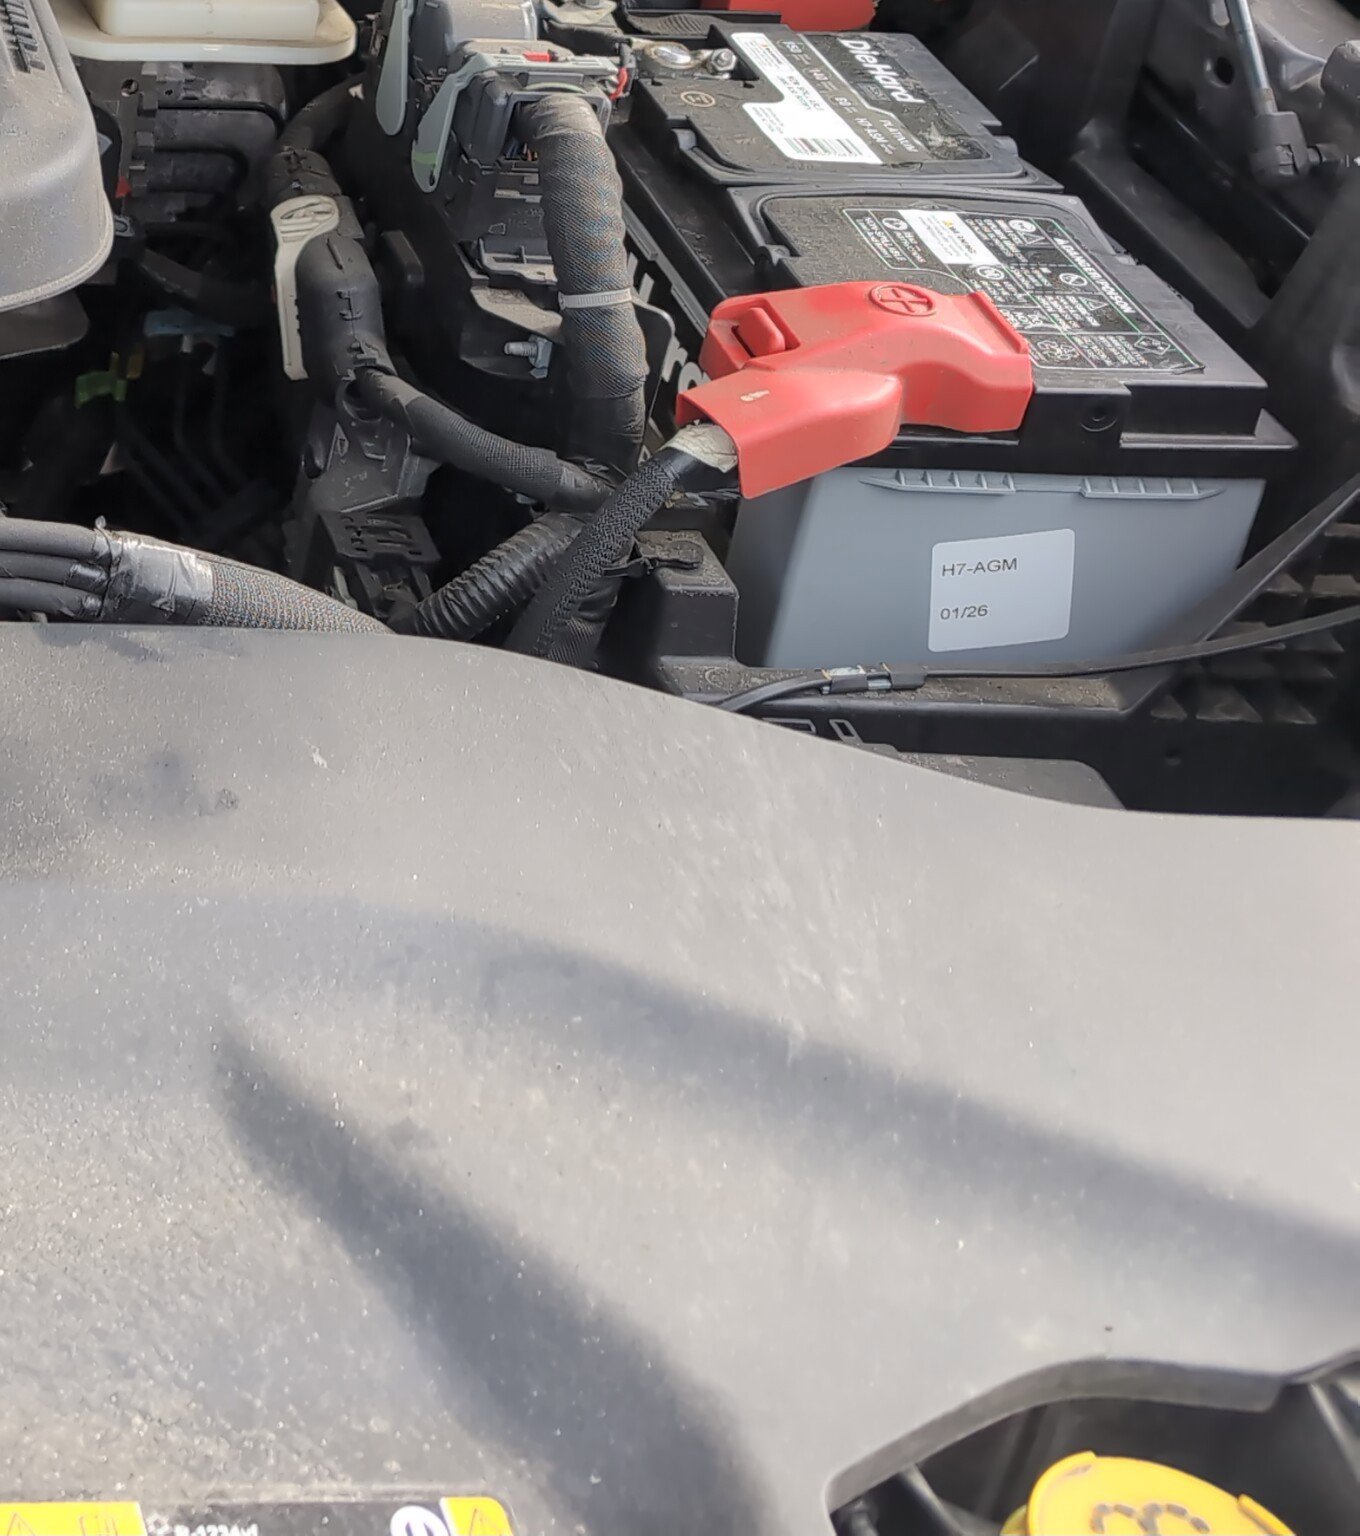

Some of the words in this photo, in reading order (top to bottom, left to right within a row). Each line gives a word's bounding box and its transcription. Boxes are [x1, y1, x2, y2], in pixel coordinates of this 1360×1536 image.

[837, 38, 926, 104] DieHard
[941, 558, 1018, 577] H7-AGM
[940, 604, 988, 620] 01/26
